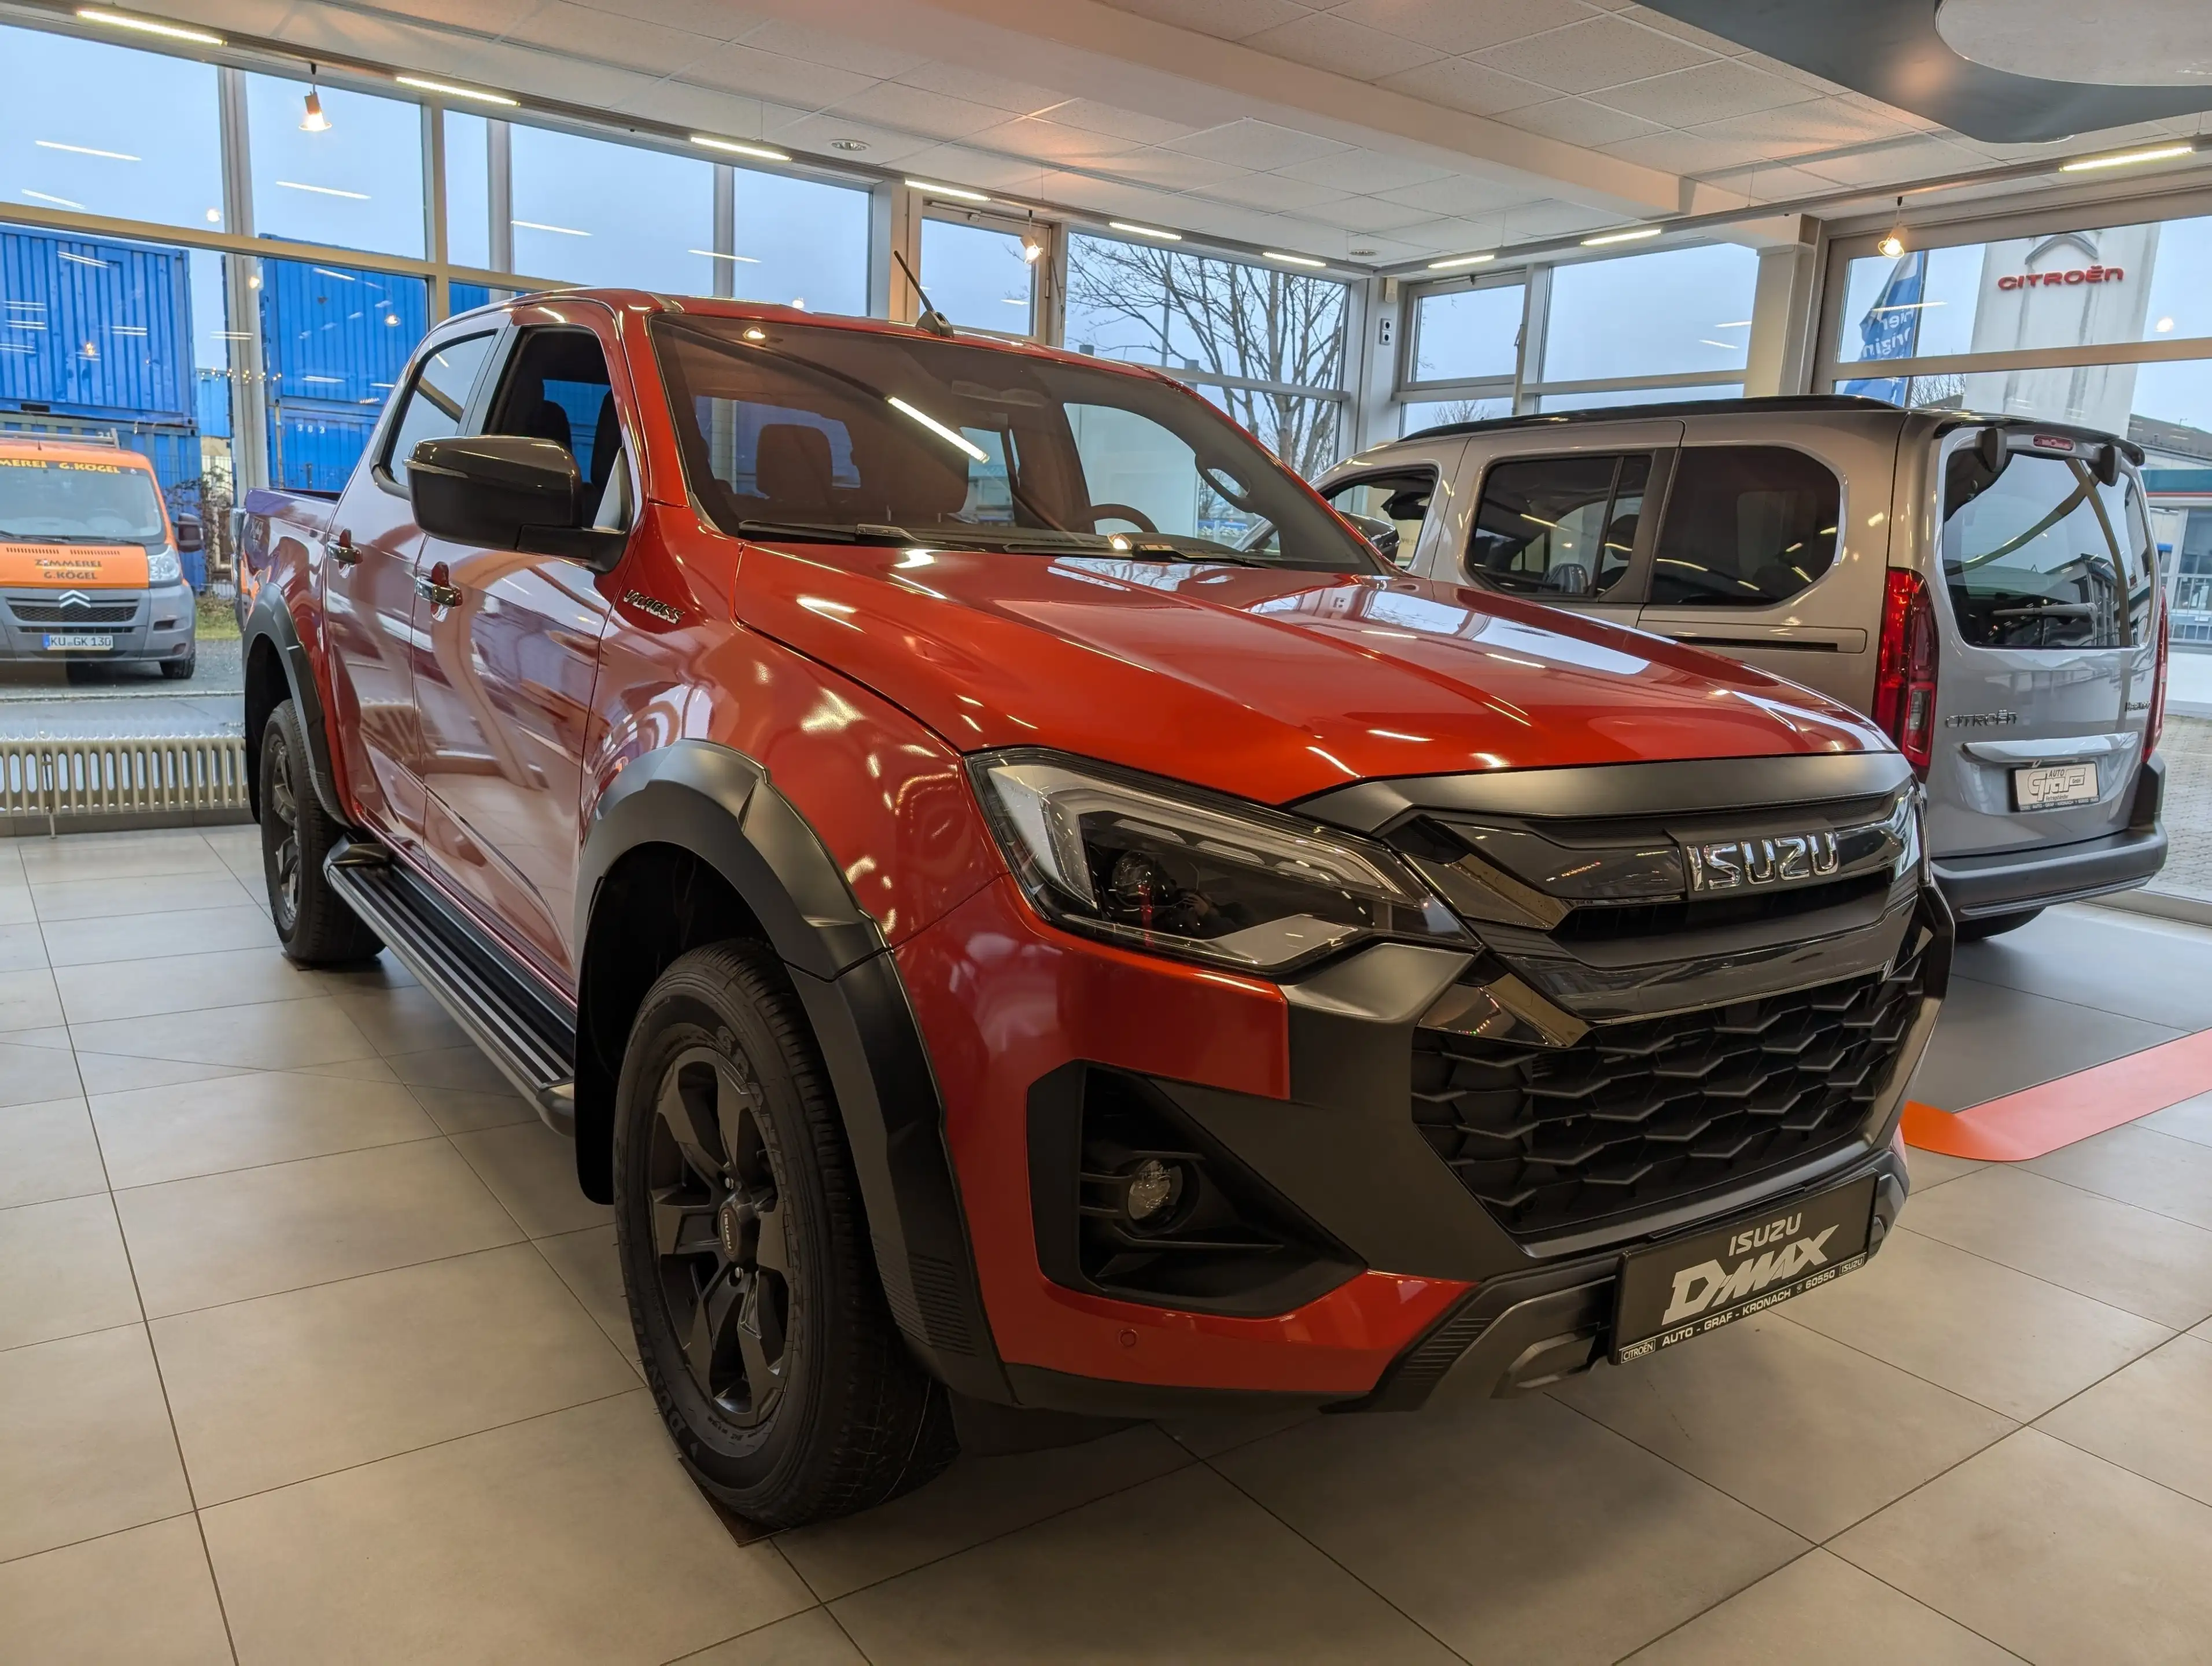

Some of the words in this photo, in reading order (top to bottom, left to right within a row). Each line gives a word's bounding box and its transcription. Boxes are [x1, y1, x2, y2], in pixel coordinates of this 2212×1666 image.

[51, 637, 66, 646] KU
[73, 637, 89, 646] GK
[90, 637, 111, 646] 130
[2049, 769, 2064, 777] AUTO
[1686, 831, 1839, 891] ISUZU
[1728, 1212, 1802, 1256] ISUZU
[1841, 1258, 1863, 1273] ISUZU
[1662, 1326, 1693, 1347] AUTO
[1704, 1311, 1733, 1330] GRAF
[1742, 1288, 1791, 1316] KRONACH
[1805, 1269, 1835, 1289] 60550
[1623, 1342, 1653, 1360] CITROËN
